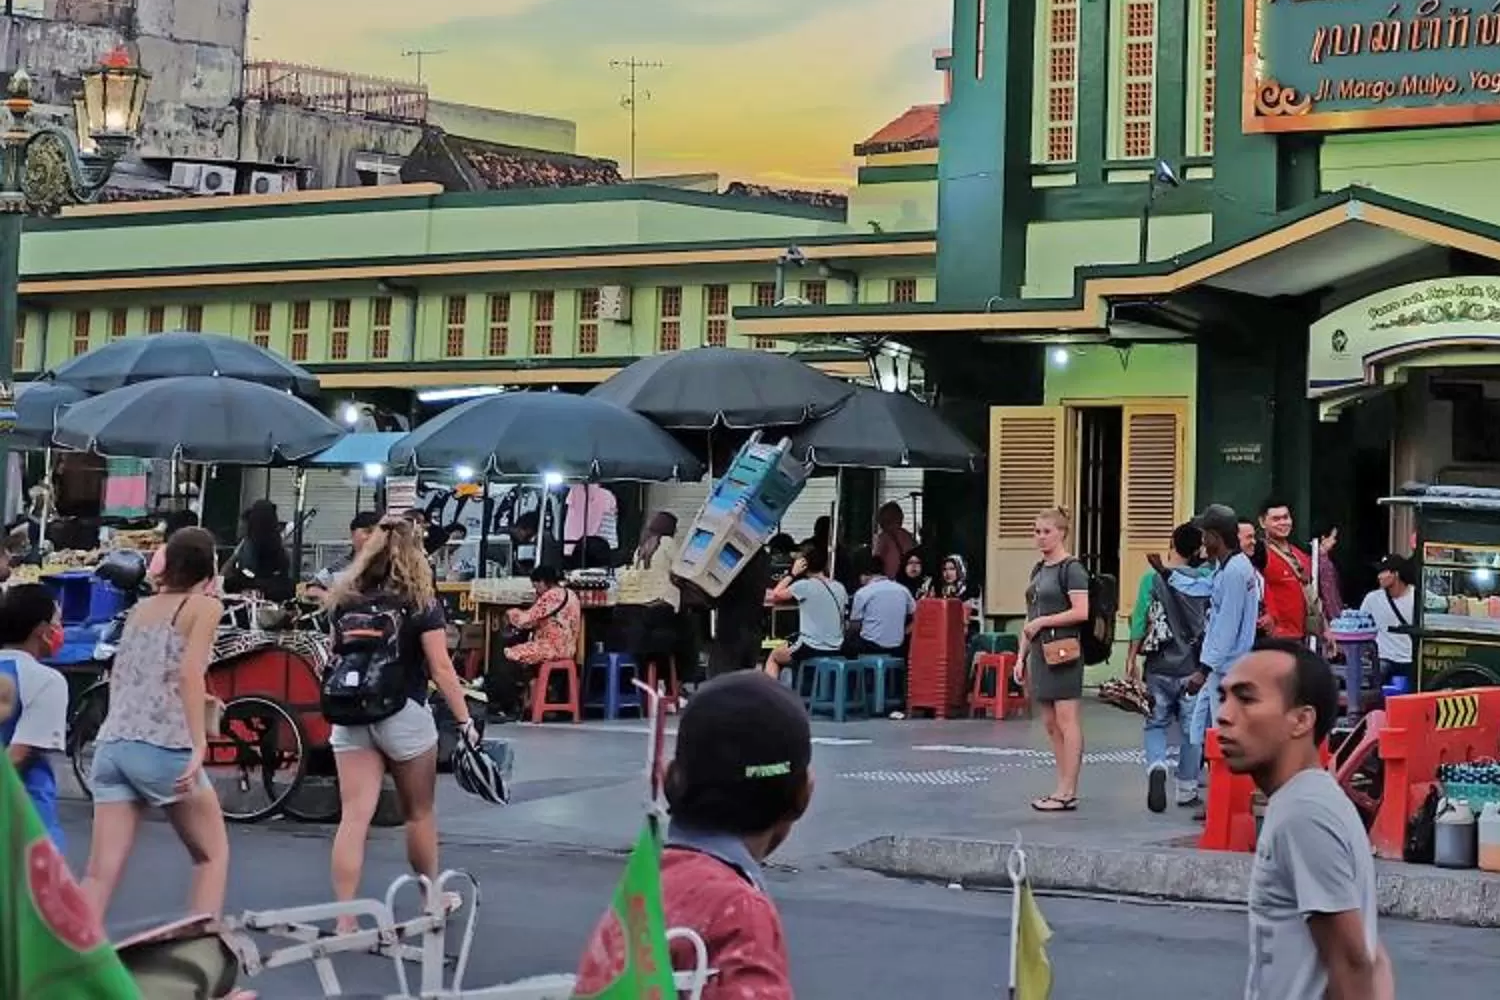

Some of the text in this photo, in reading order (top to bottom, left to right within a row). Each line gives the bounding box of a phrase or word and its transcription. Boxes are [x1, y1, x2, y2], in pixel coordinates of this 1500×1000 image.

[1314, 79, 1334, 100] Jl.
[1339, 78, 1396, 103] Margo
[1400, 73, 1463, 98] Mulyo,
